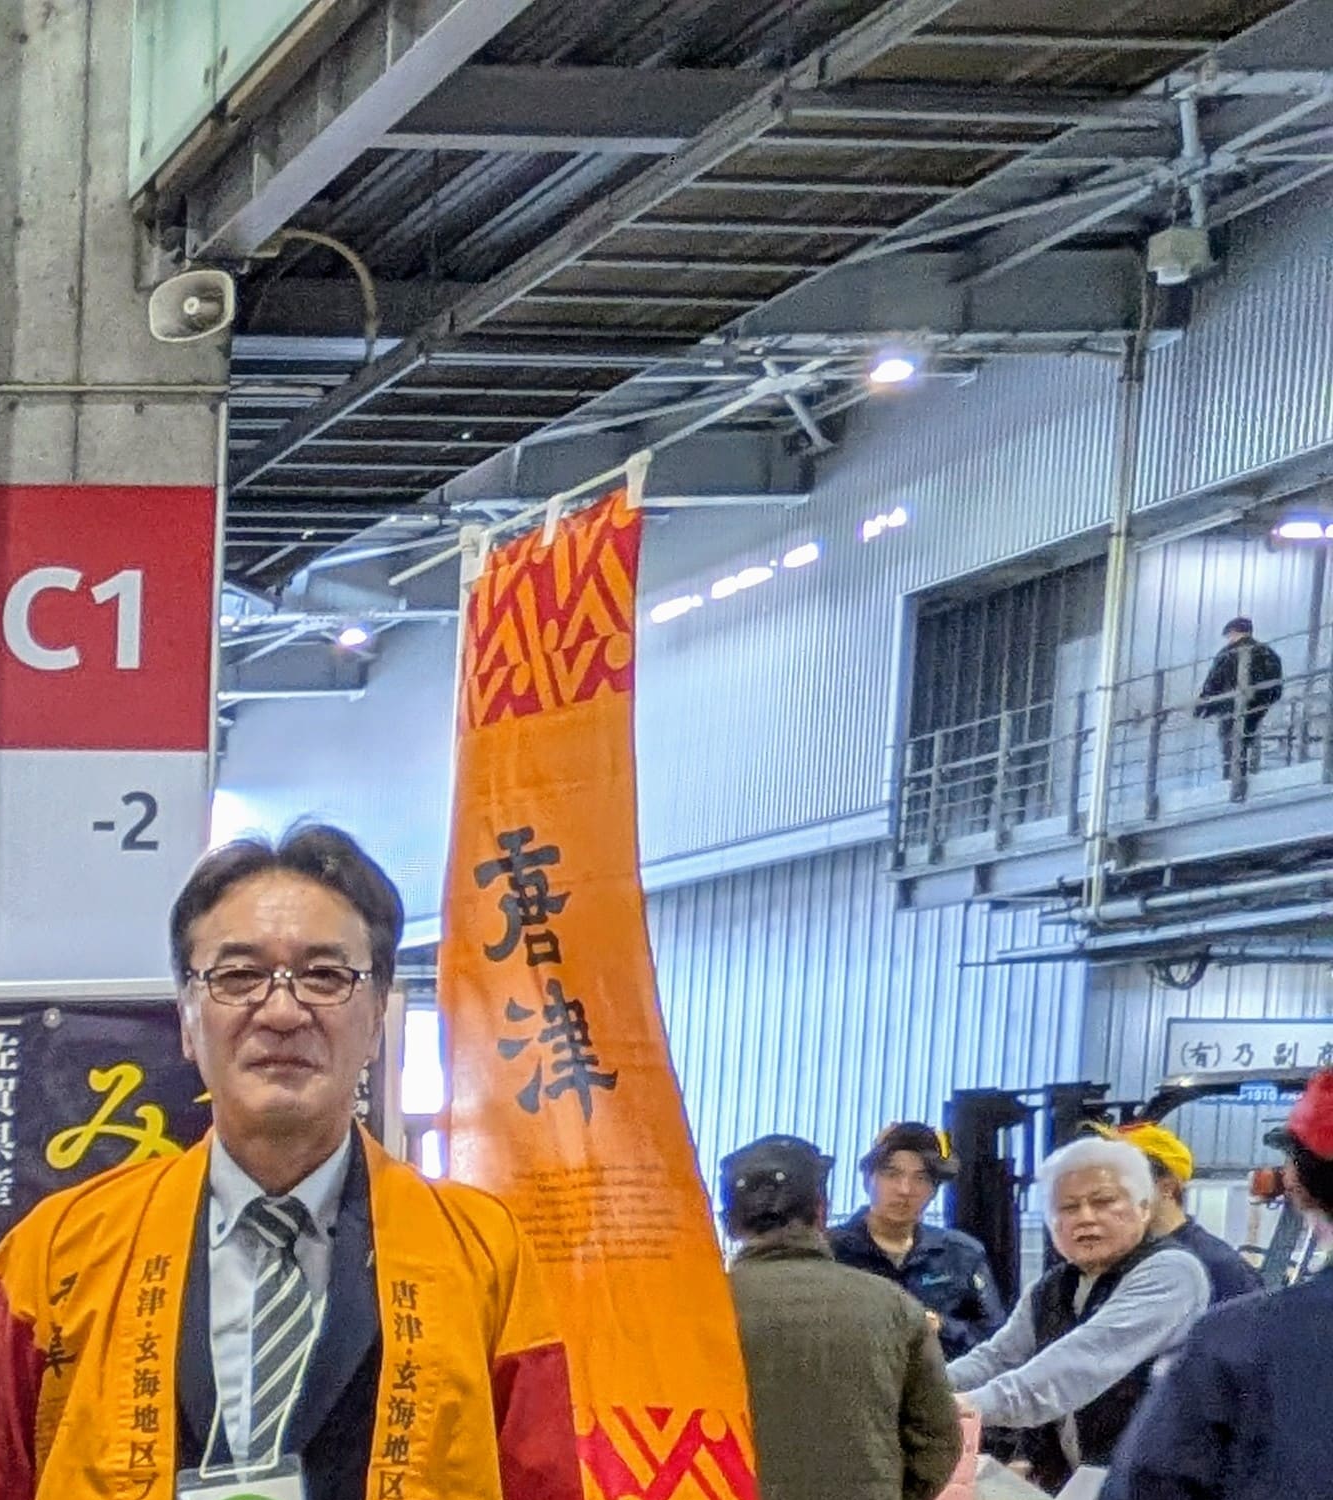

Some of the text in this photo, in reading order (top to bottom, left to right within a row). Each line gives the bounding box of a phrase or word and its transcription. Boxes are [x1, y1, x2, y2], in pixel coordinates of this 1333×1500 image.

[2, 565, 144, 672] C1
[92, 790, 159, 852] -2
[473, 826, 619, 1125] 唐津
